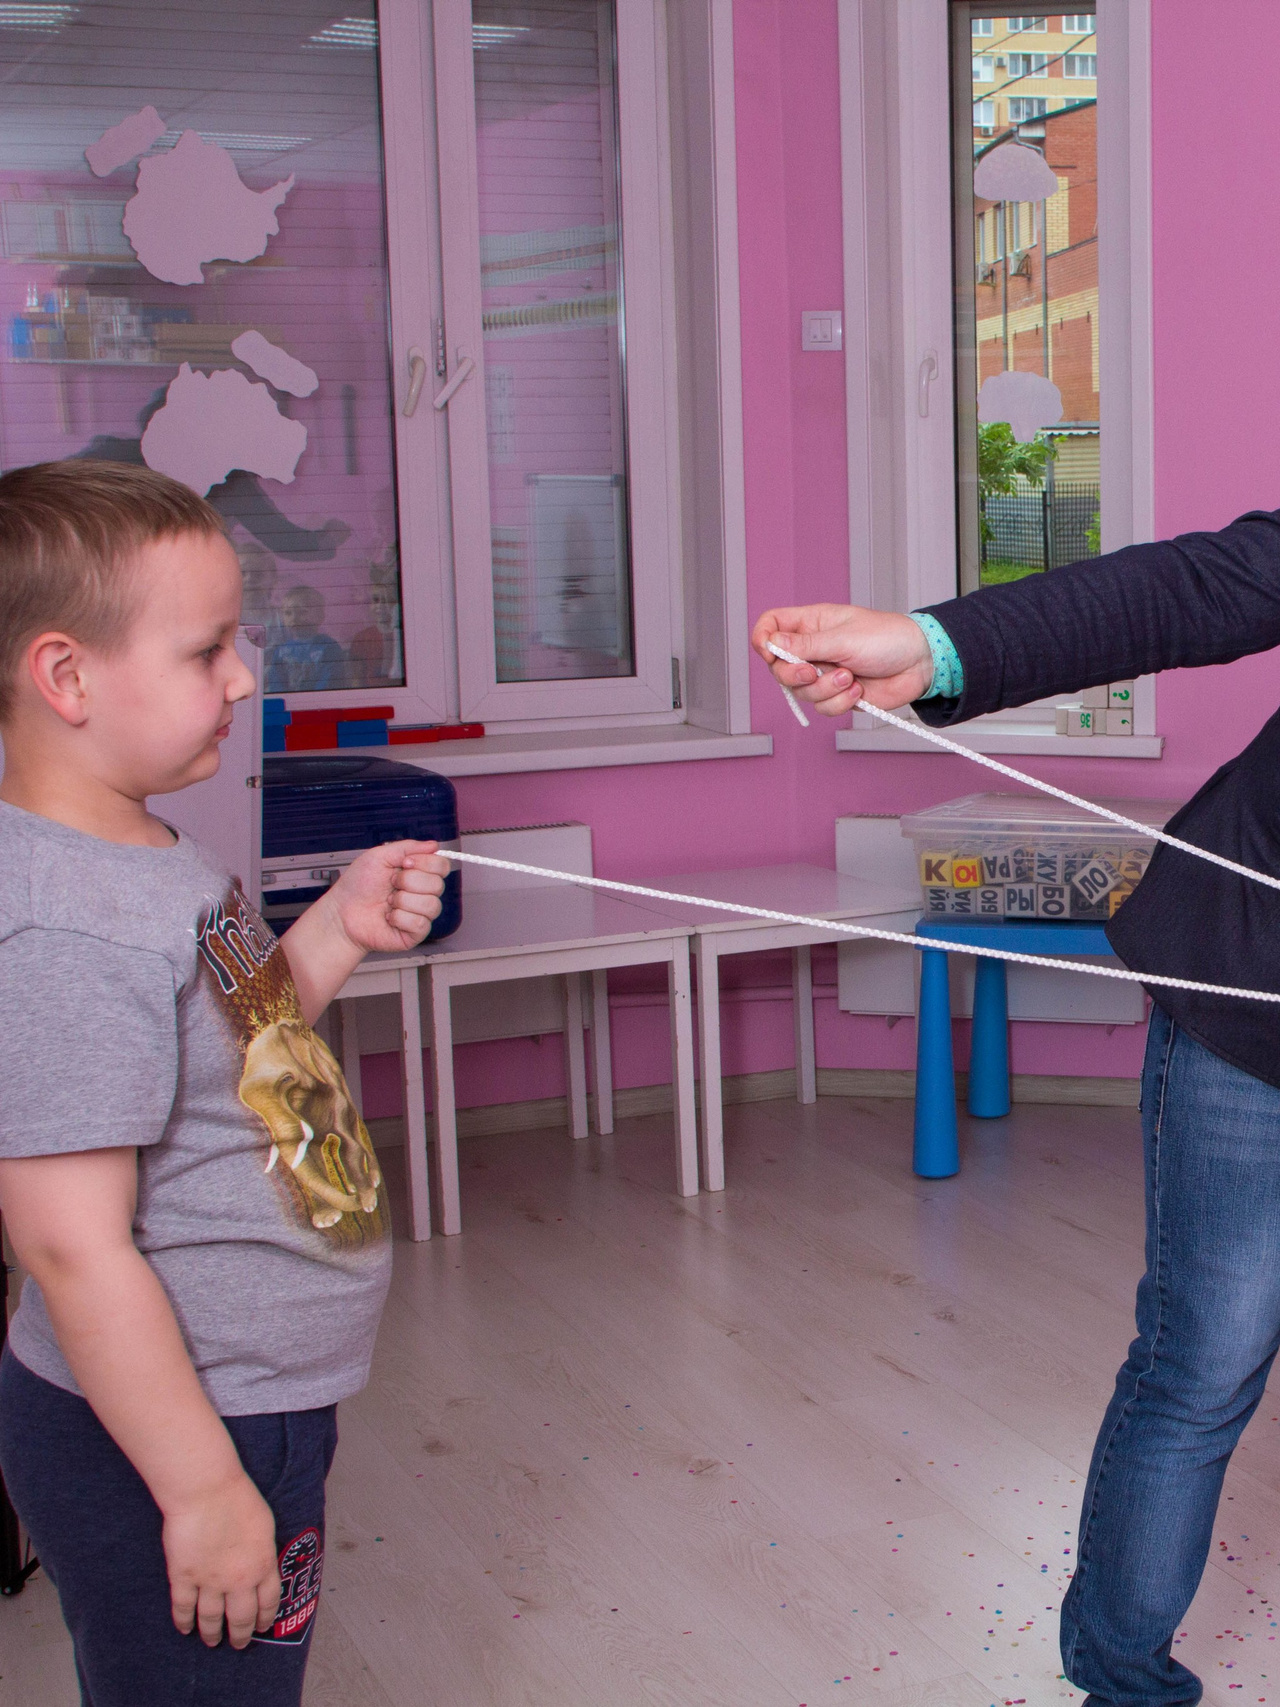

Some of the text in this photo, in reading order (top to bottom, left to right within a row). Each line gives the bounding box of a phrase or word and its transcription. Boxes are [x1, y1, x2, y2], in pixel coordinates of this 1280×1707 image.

[925, 859, 947, 882] К
[1006, 889, 1034, 911] РЫ
[1042, 886, 1065, 915] БО
